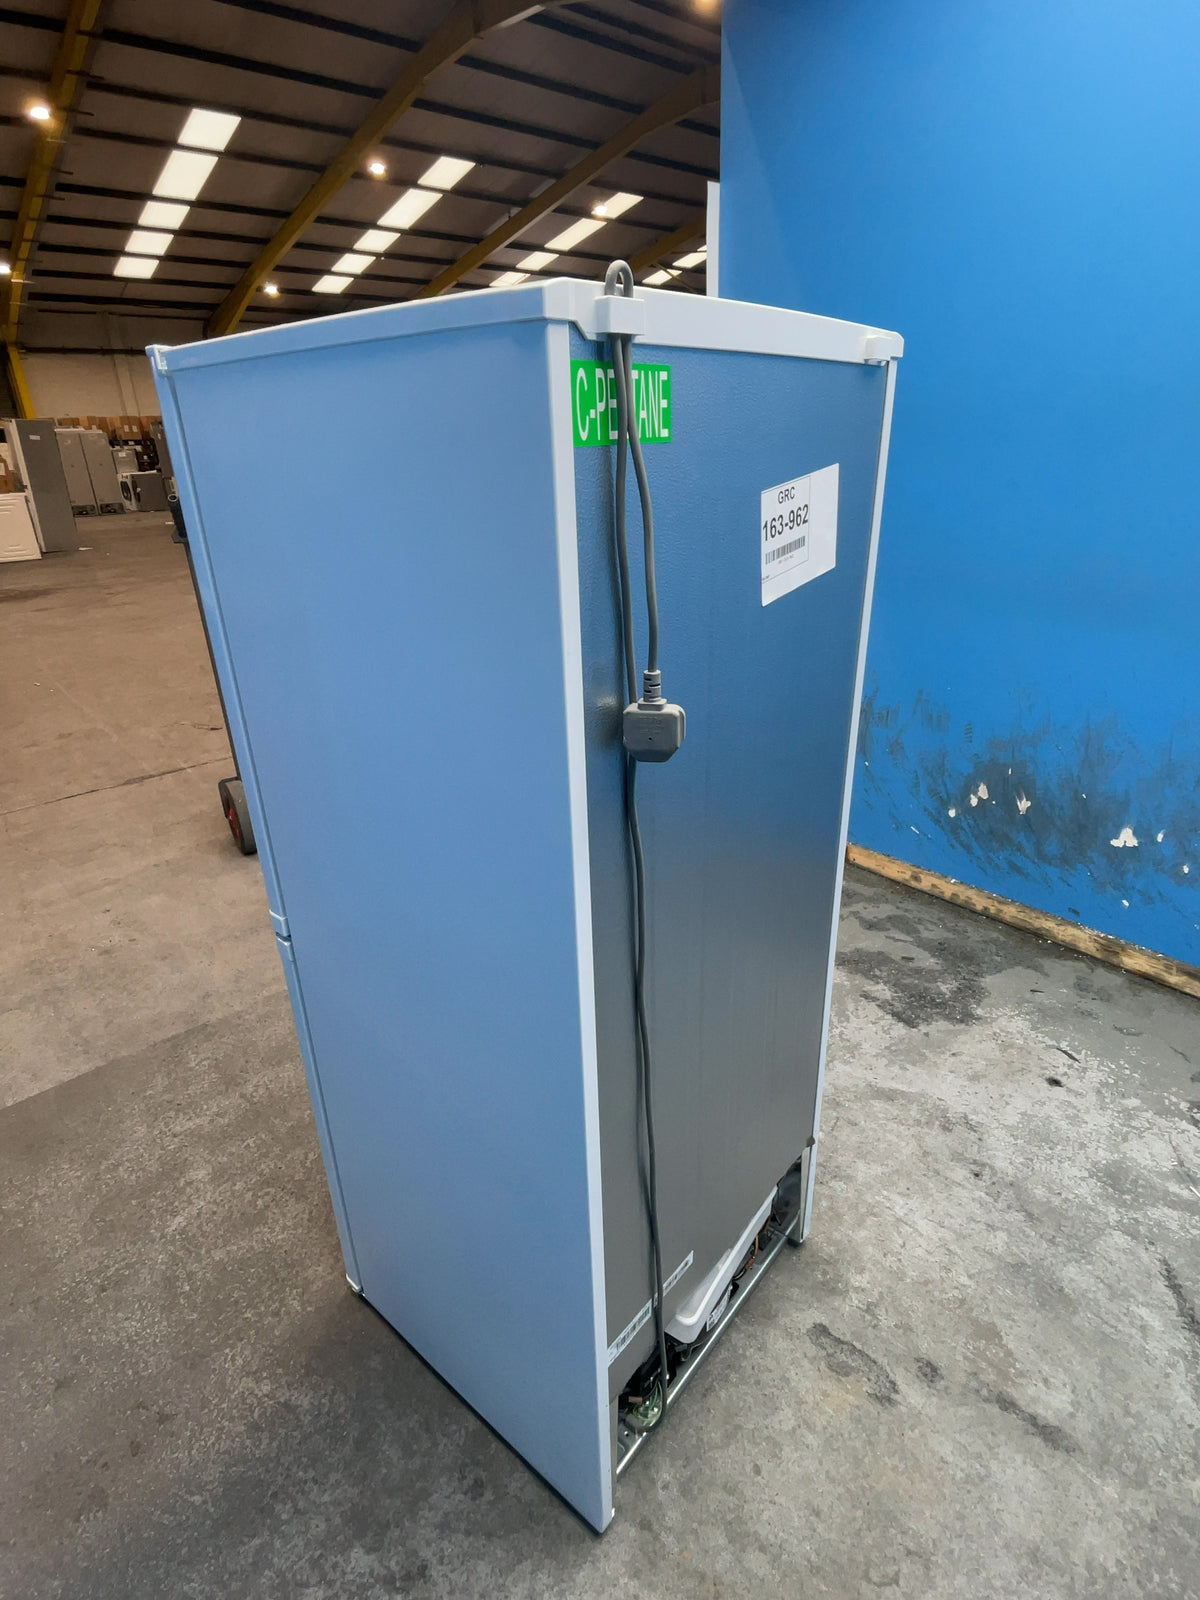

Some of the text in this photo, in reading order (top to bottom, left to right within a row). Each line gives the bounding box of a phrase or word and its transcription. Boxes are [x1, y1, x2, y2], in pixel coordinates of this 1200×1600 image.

[576, 367, 670, 442] C-PETANE
[777, 486, 796, 504] GRC
[762, 504, 809, 542] 163-962
